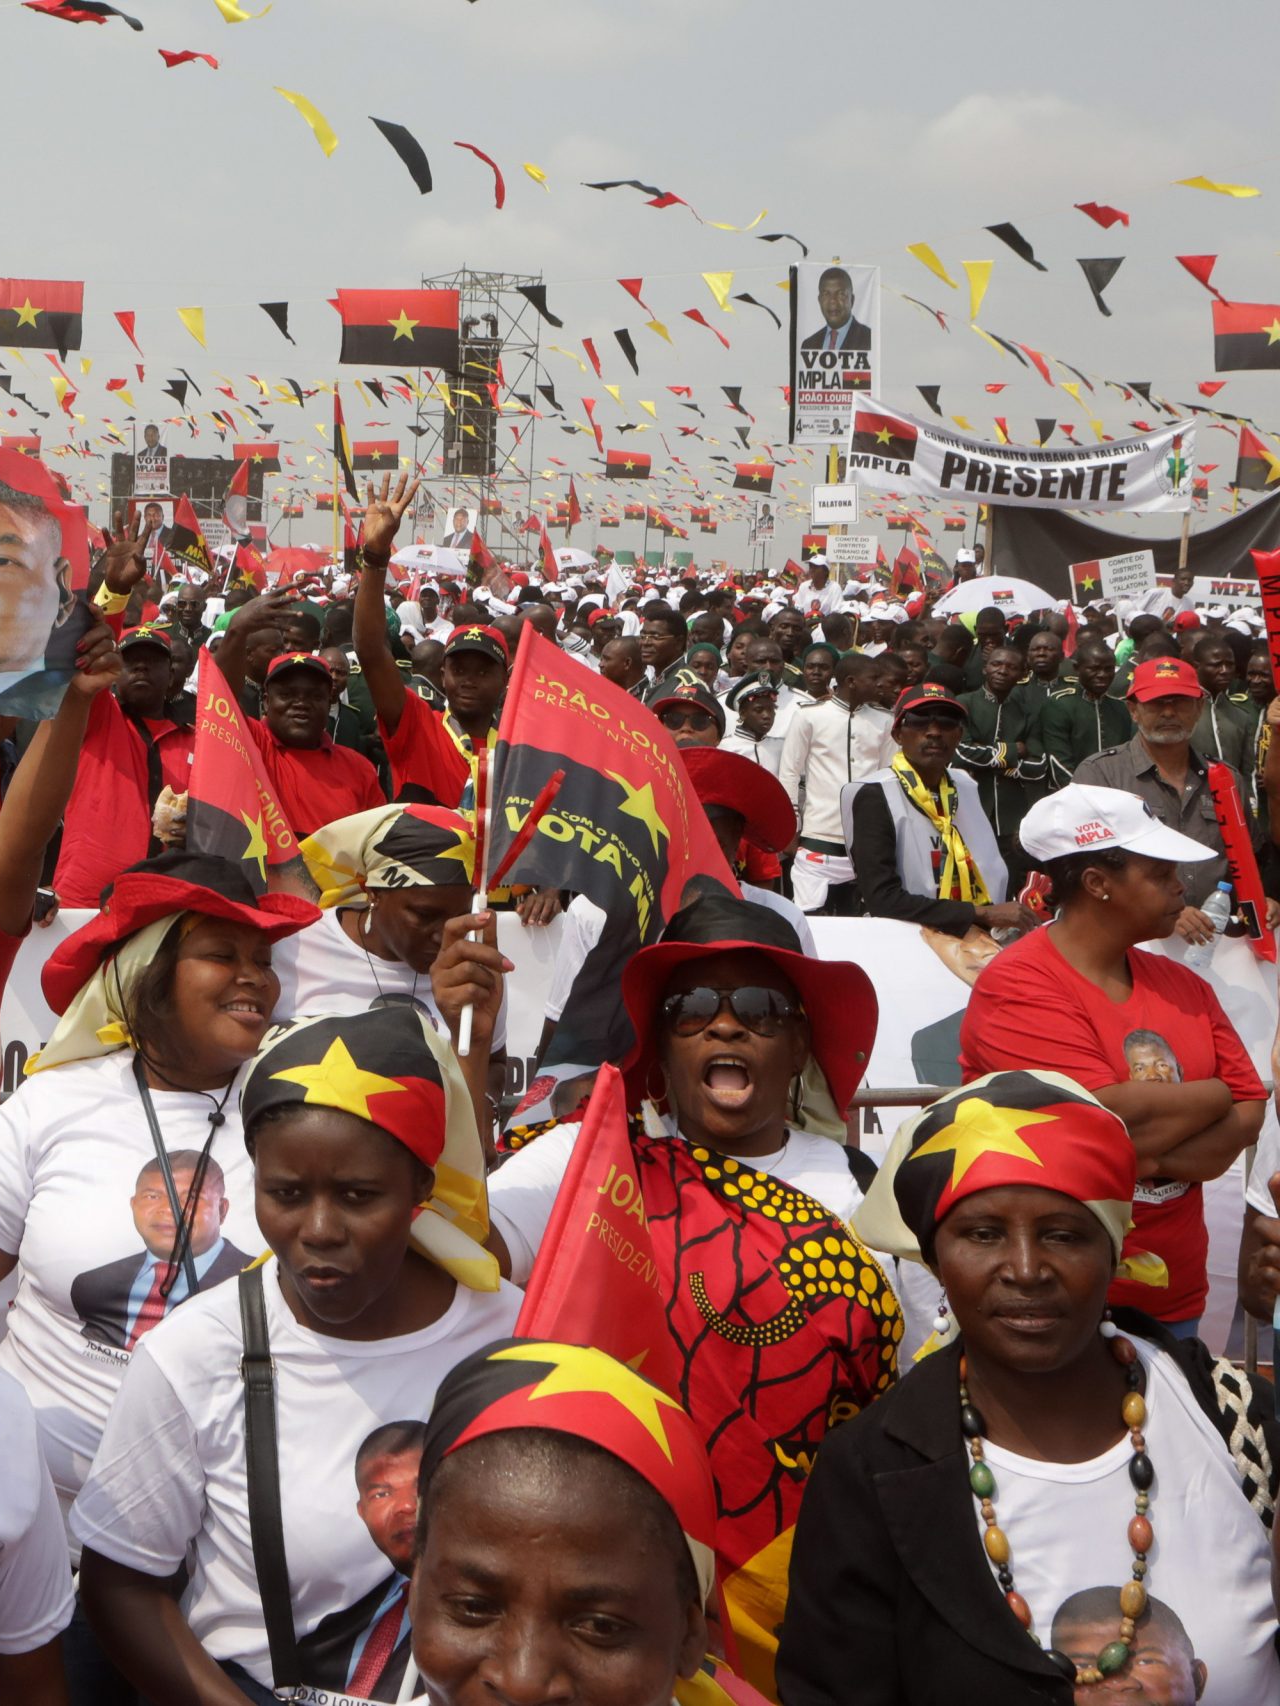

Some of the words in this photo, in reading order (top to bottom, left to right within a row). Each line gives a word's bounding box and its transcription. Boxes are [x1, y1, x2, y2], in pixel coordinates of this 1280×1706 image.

[800, 351, 871, 370] VOTA
[798, 370, 842, 390] MPLA
[800, 391, 823, 403] JOÃO
[795, 418, 803, 434] 4
[923, 429, 961, 451] COMITÉ
[962, 442, 977, 454] DO
[978, 445, 1026, 462] DISTRITO
[1029, 450, 1075, 463] URBANO
[1077, 450, 1093, 462] DE
[1094, 441, 1150, 460] TALATONA
[136, 457, 167, 465] VOTA
[849, 453, 912, 477] MPLA
[136, 465, 156, 473] MPLA
[939, 450, 1129, 502] PRESENTE
[818, 499, 853, 508] TALATONA
[1135, 554, 1145, 562] DO
[1112, 563, 1143, 575] DISTRITO
[1108, 573, 1138, 584] URBANO
[1112, 580, 1149, 593] TALATONA
[560, 808, 594, 830] COM
[595, 826, 608, 838] O
[1075, 821, 1103, 834] VOTA
[504, 806, 624, 881] VOTA
[1073, 828, 1115, 846] MPLA
